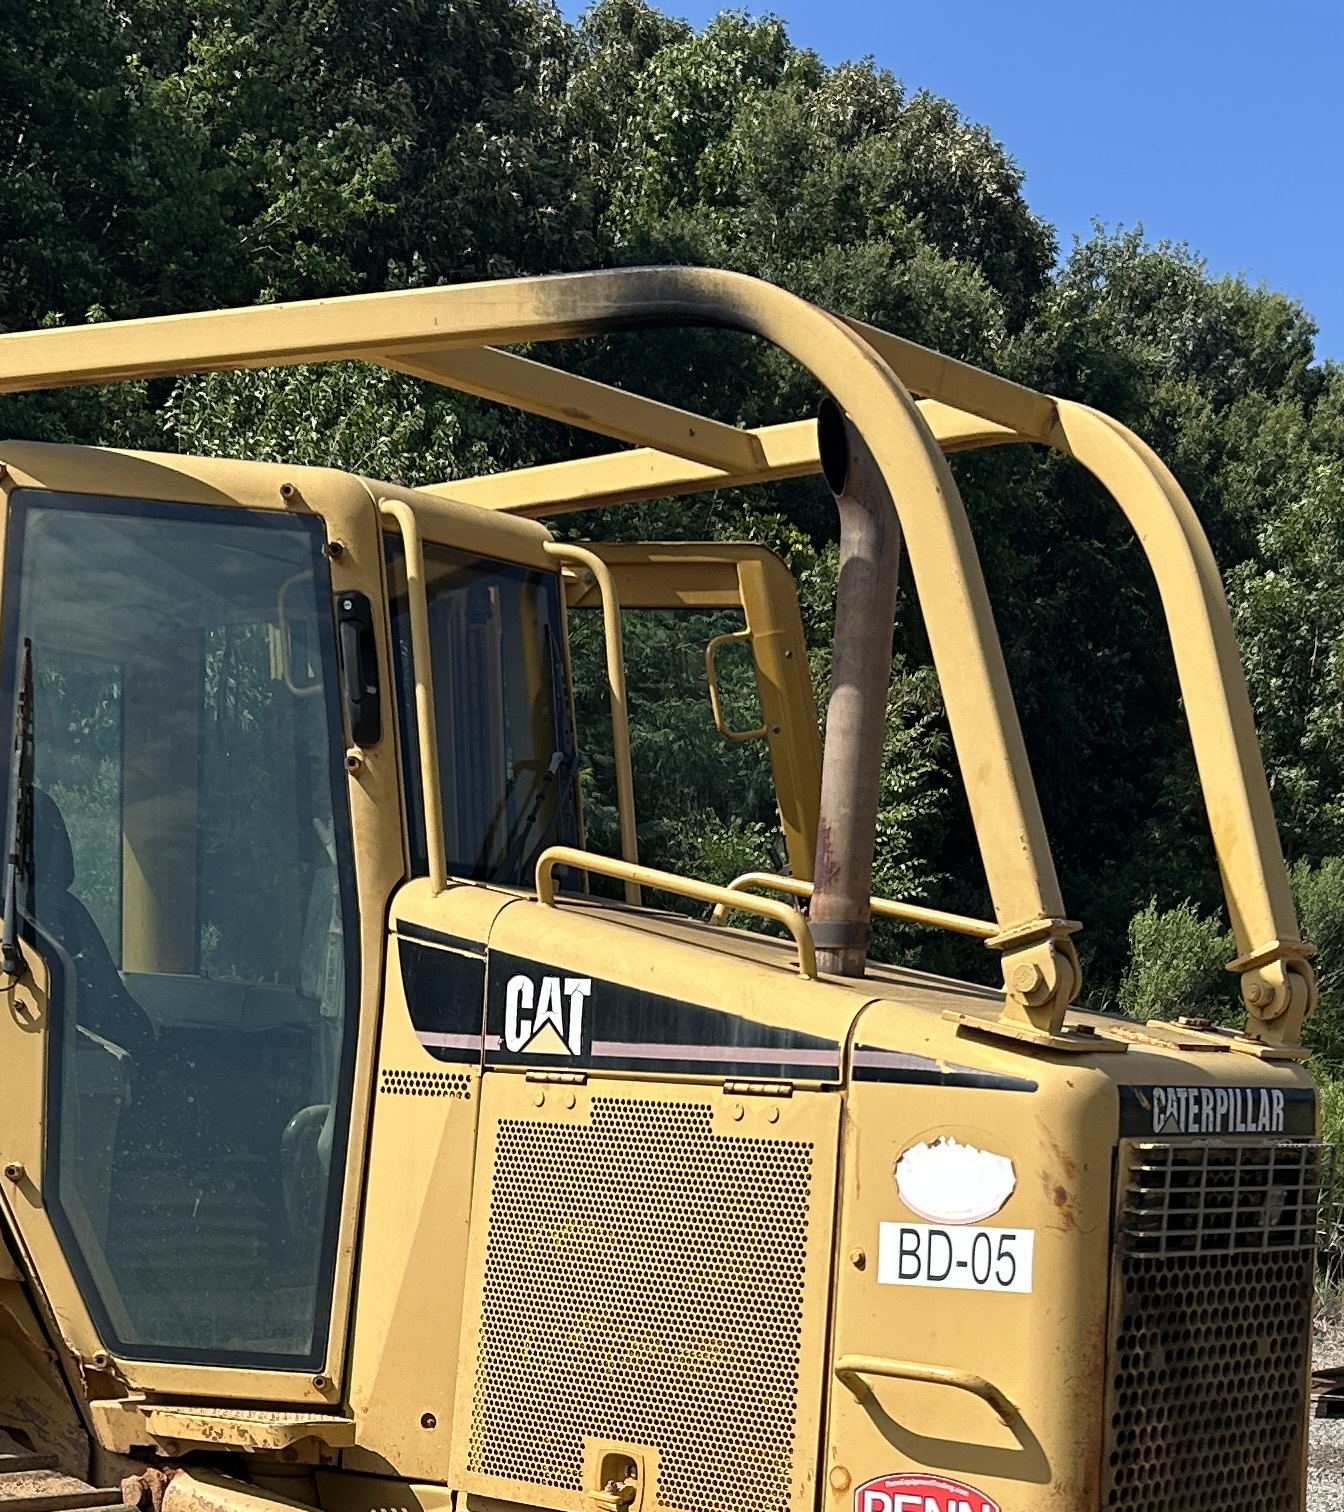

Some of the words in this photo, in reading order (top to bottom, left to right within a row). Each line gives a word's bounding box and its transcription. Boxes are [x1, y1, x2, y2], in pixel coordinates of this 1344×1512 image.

[504, 974, 591, 1056] CAT
[1152, 1087, 1285, 1134] CATERPILLAR
[898, 1228, 1017, 1287] BD-05
